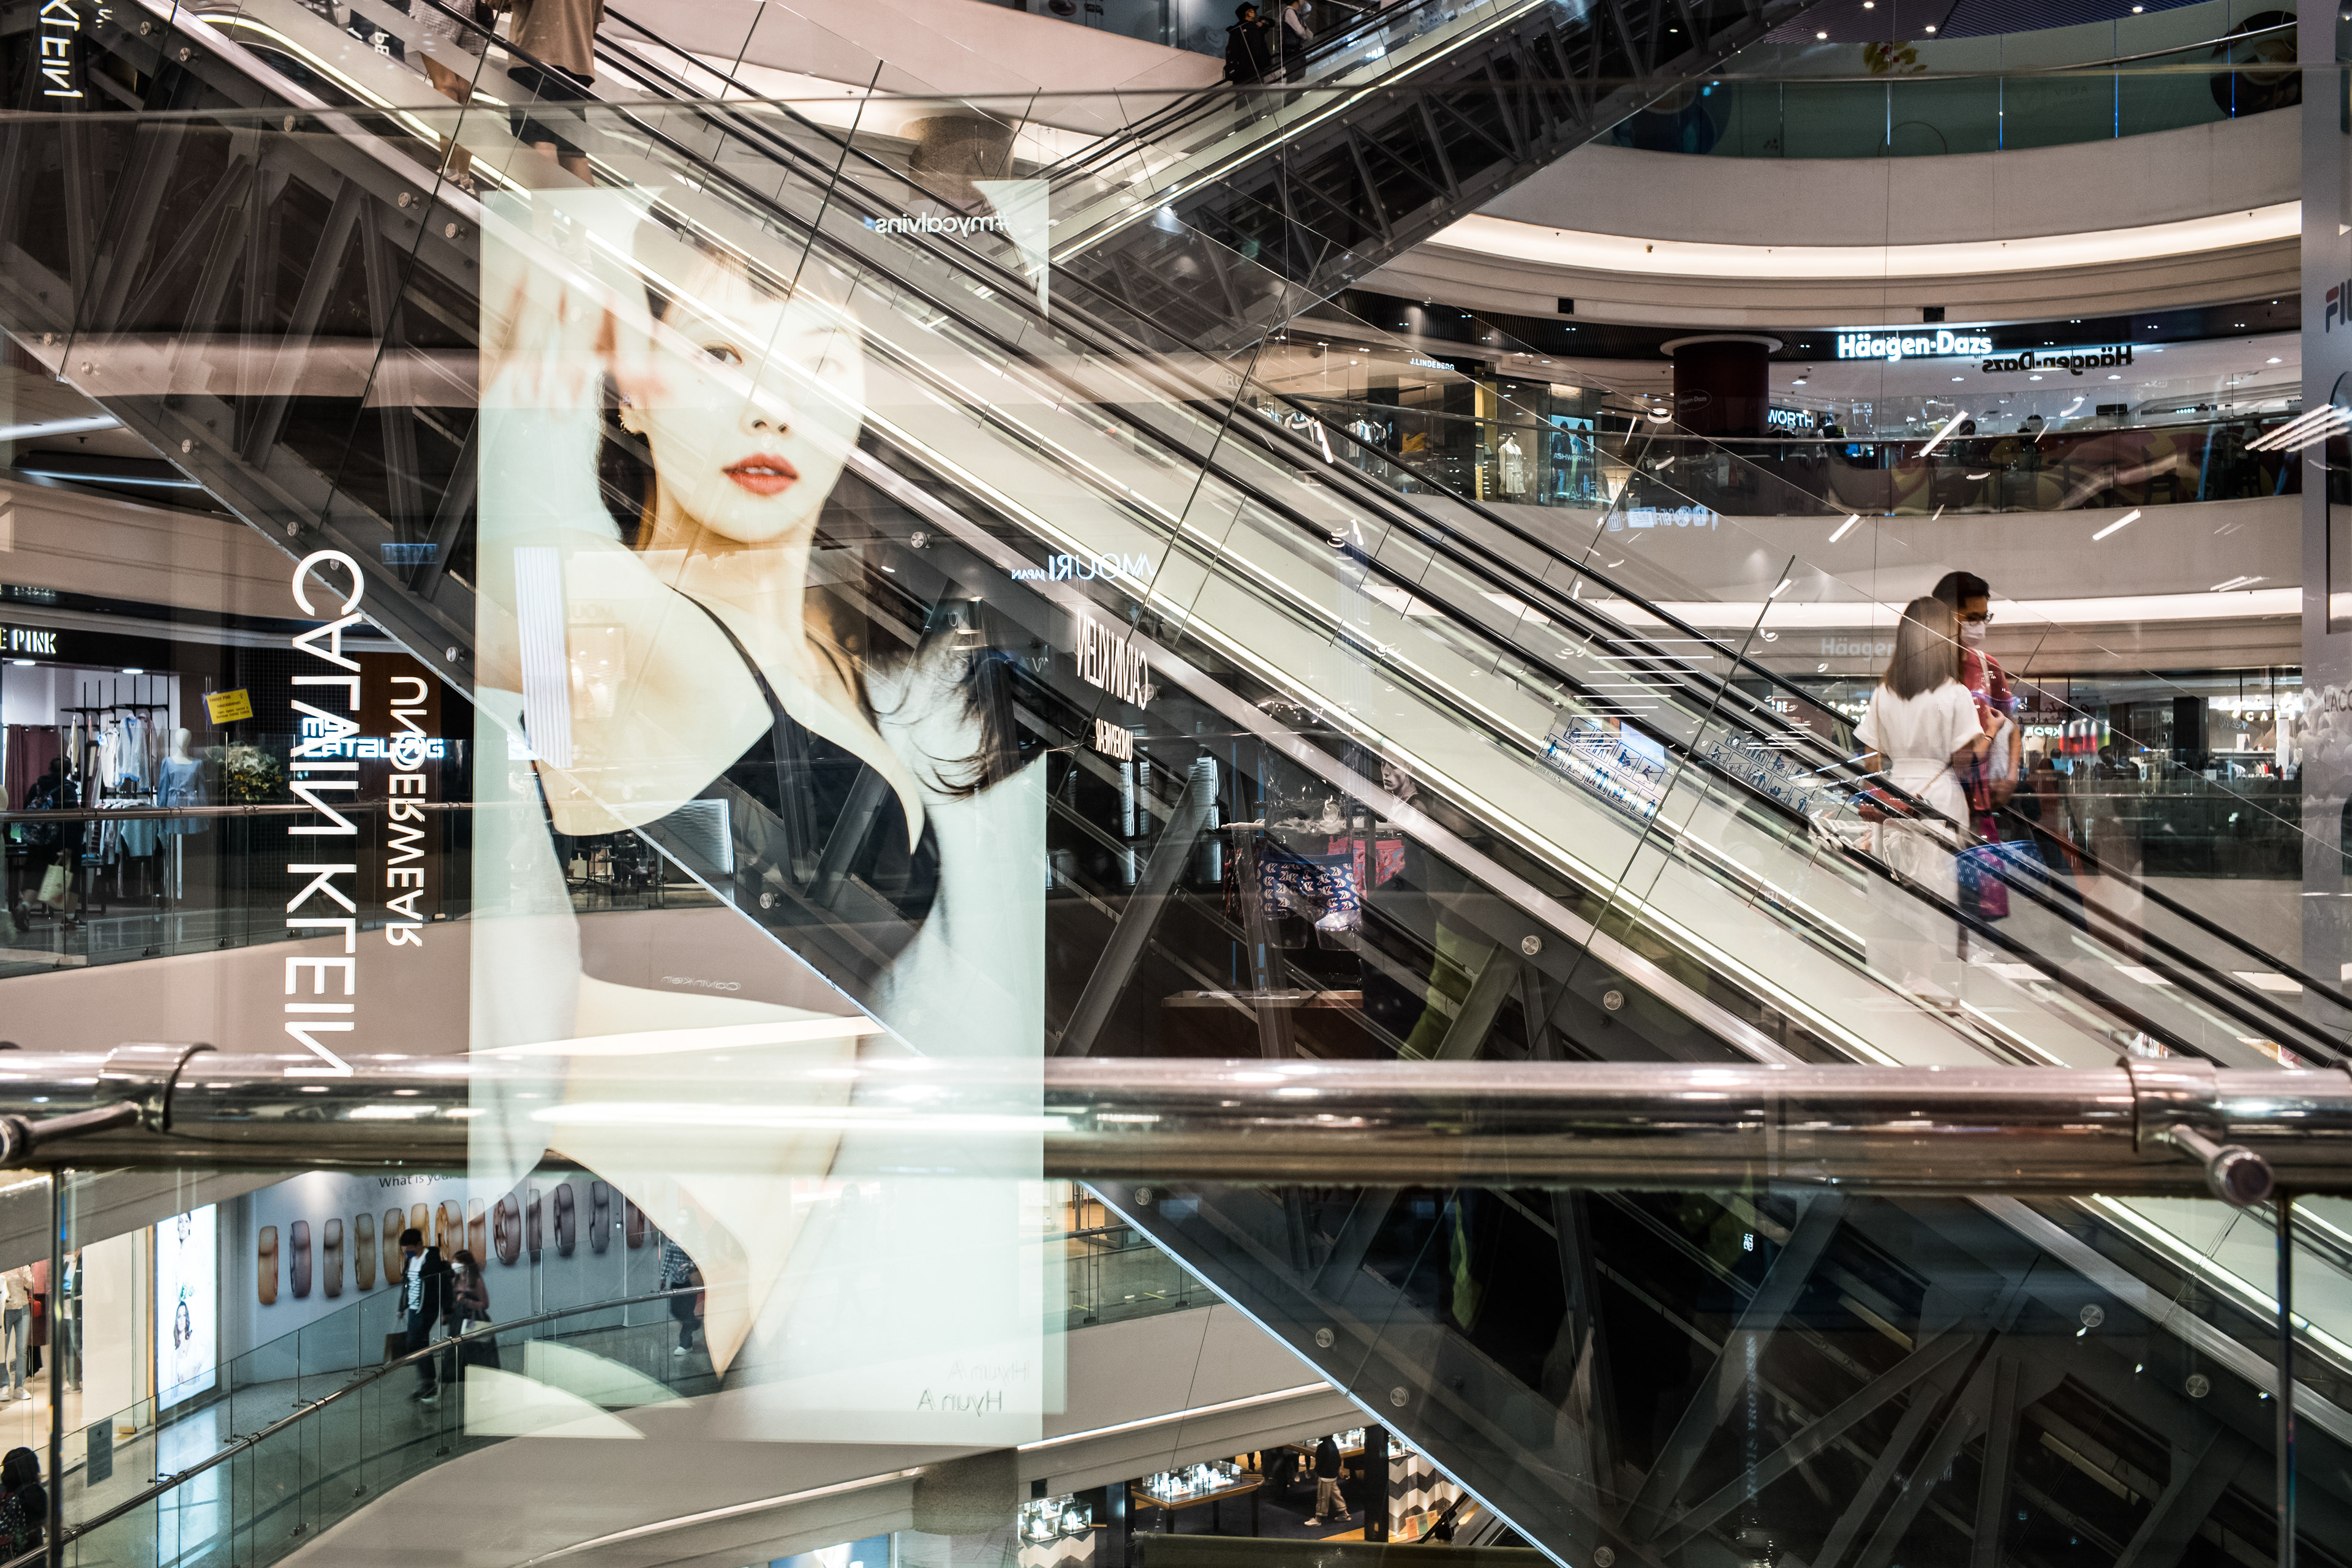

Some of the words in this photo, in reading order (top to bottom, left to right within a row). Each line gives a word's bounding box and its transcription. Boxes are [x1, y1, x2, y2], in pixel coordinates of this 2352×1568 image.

[1838, 331, 1992, 362] Häagen-Dazs
[1409, 357, 1455, 371] J.LINDEBERG
[10, 629, 56, 654] PINK
[379, 1176, 412, 1188] What
[427, 1174, 452, 1185] you
